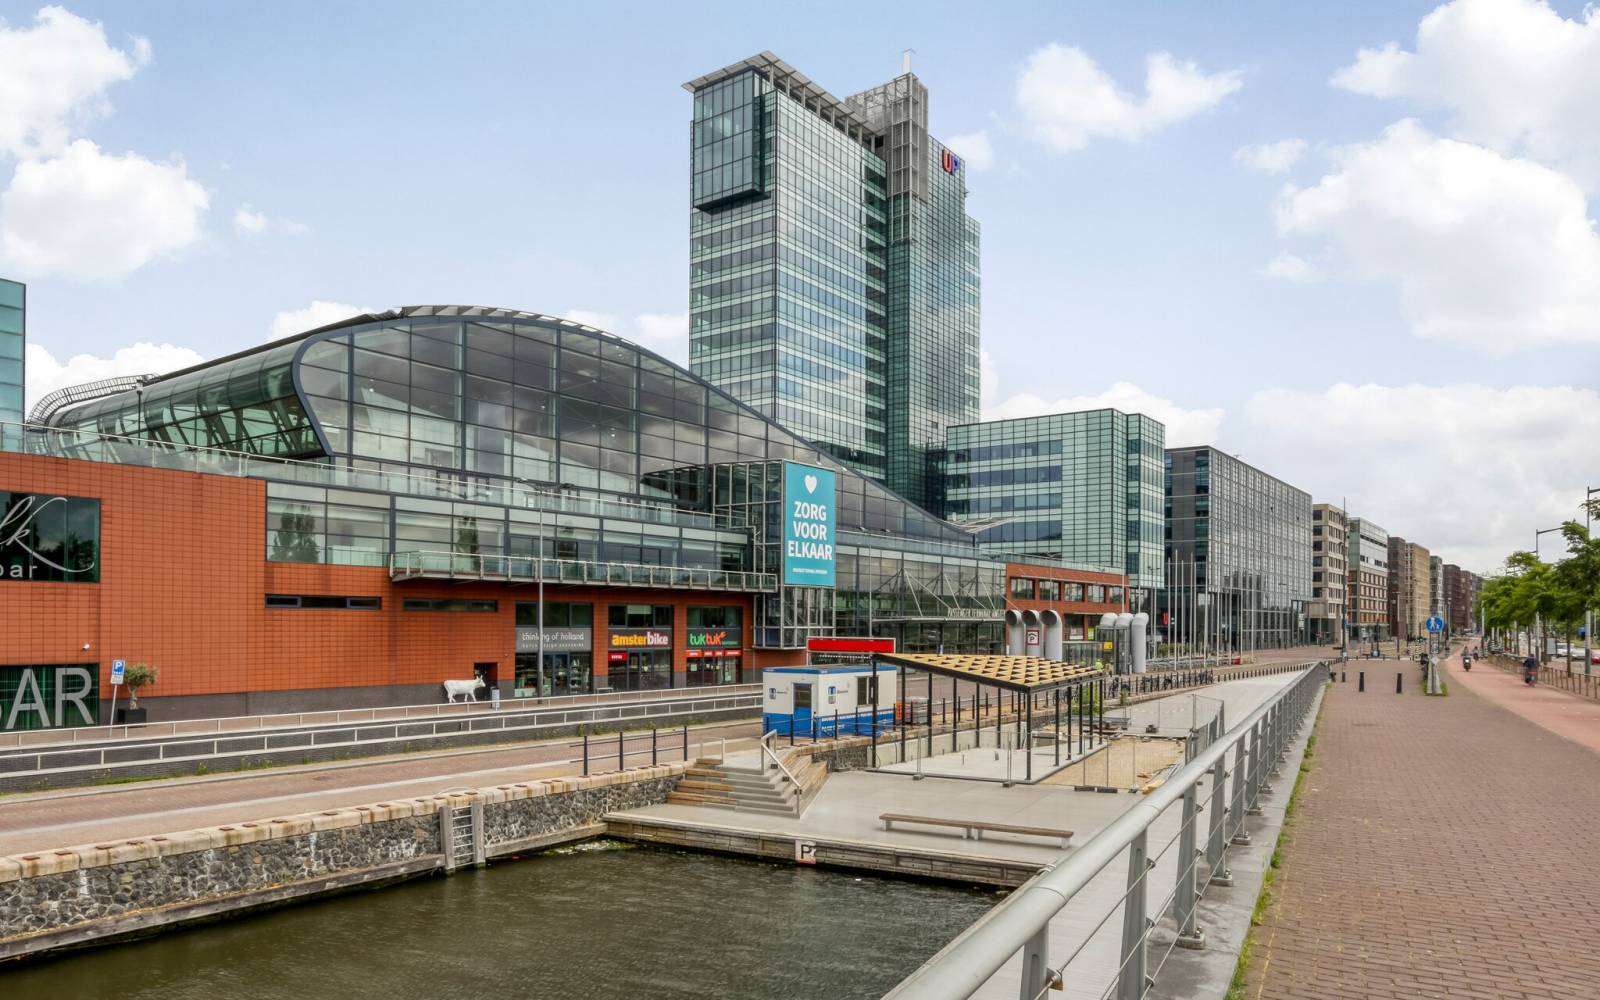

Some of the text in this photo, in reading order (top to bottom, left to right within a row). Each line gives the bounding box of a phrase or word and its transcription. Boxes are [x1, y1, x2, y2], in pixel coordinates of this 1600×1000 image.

[793, 500, 827, 521] ZORG
[793, 521, 827, 541] VOOR
[787, 540, 833, 560] ELKAAR
[522, 632, 584, 642] thinkng of holland
[611, 631, 669, 646] amsterbike
[115, 661, 122, 670] P
[0, 667, 95, 729] AR
